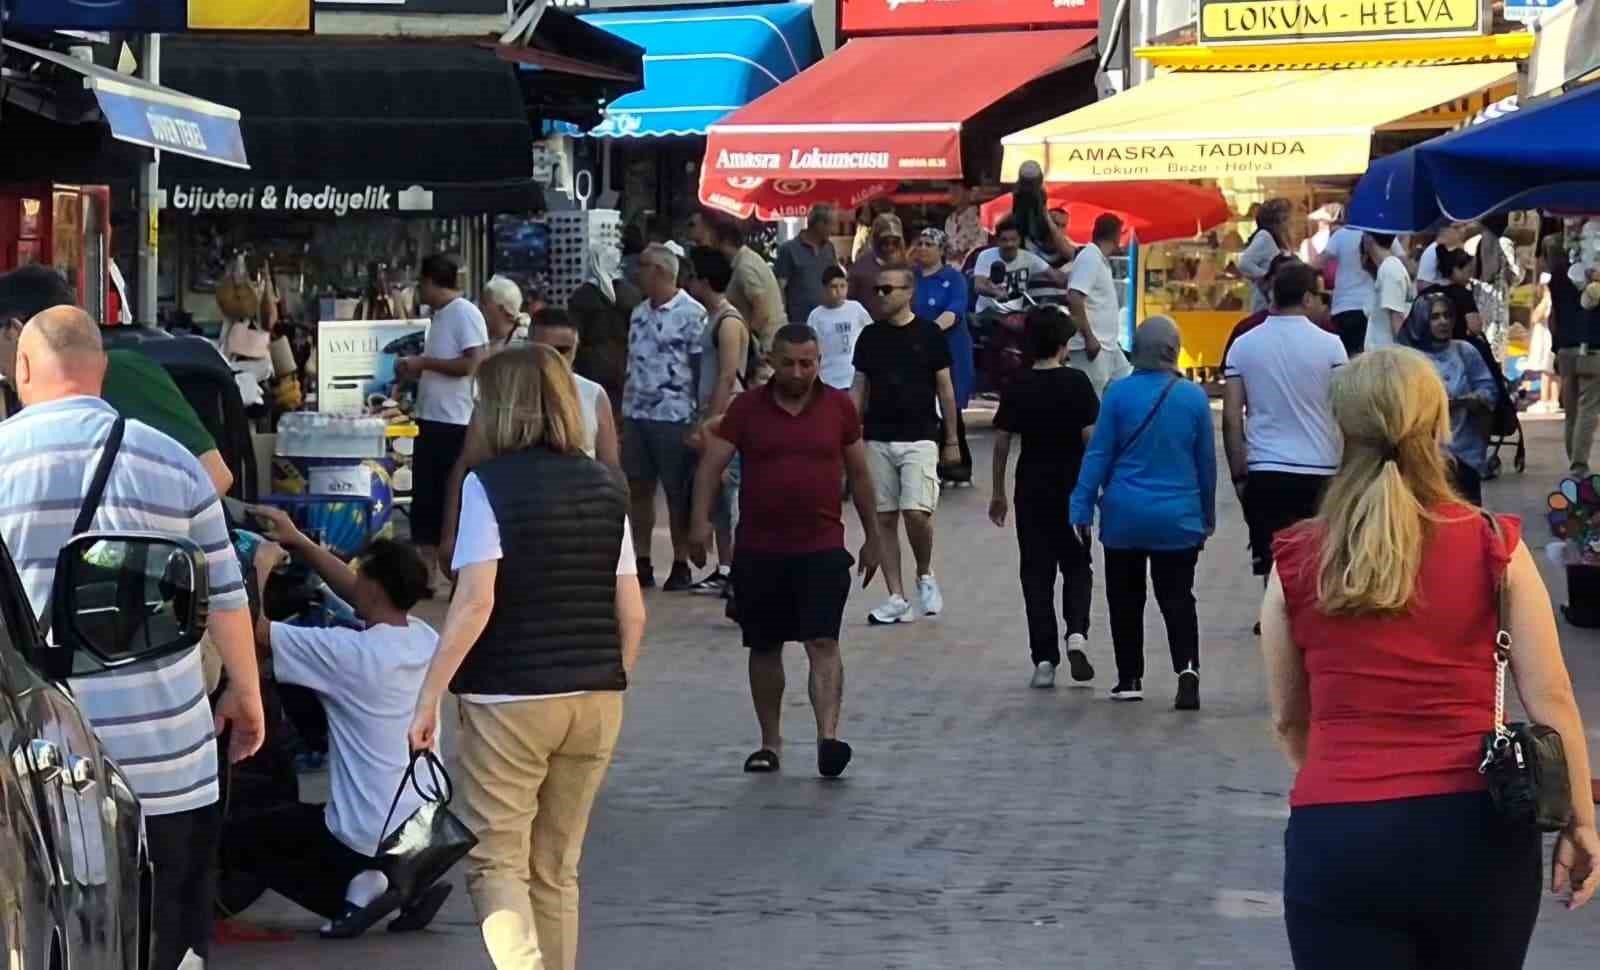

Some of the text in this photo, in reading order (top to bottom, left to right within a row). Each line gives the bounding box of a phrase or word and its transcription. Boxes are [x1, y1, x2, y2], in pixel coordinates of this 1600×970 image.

[1224, 3, 1328, 31] LOKUM
[1360, 0, 1454, 26] HELVA
[716, 148, 781, 169] Amasra
[789, 147, 889, 169] Lokumcusu
[1068, 141, 1306, 161] AMASRA TADINDA
[1092, 165, 1149, 176] Lokum
[1225, 160, 1273, 172] Helva
[173, 185, 392, 216] bijuteri & hediyelik
